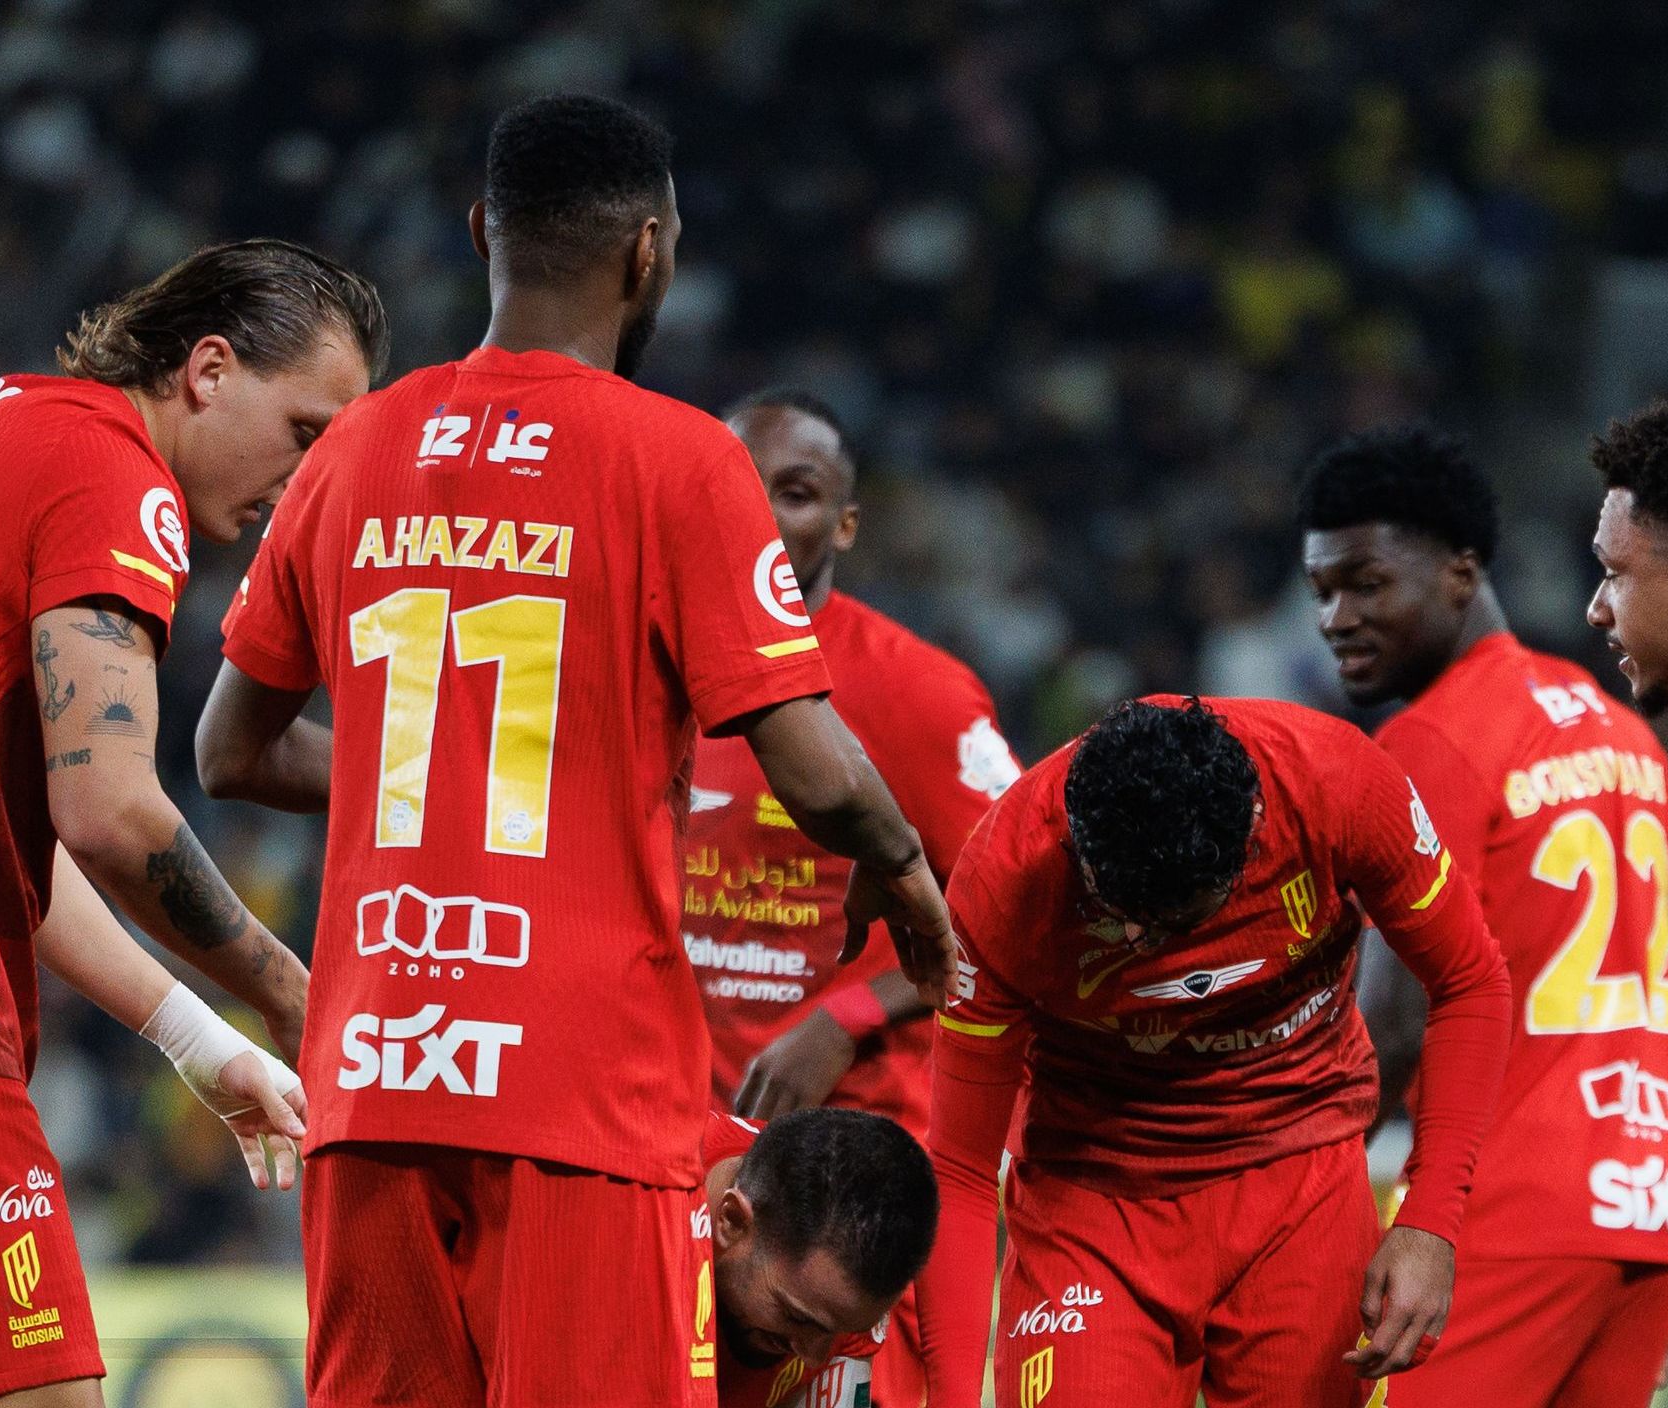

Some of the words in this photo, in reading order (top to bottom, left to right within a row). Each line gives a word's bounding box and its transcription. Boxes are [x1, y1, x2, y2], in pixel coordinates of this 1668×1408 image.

[352, 515, 575, 578] A.HAZAZI
[349, 588, 567, 858] 11
[387, 962, 465, 980] ZOHO
[1186, 976, 1212, 988] GENESIS
[11, 1325, 65, 1349] QADSIAH
